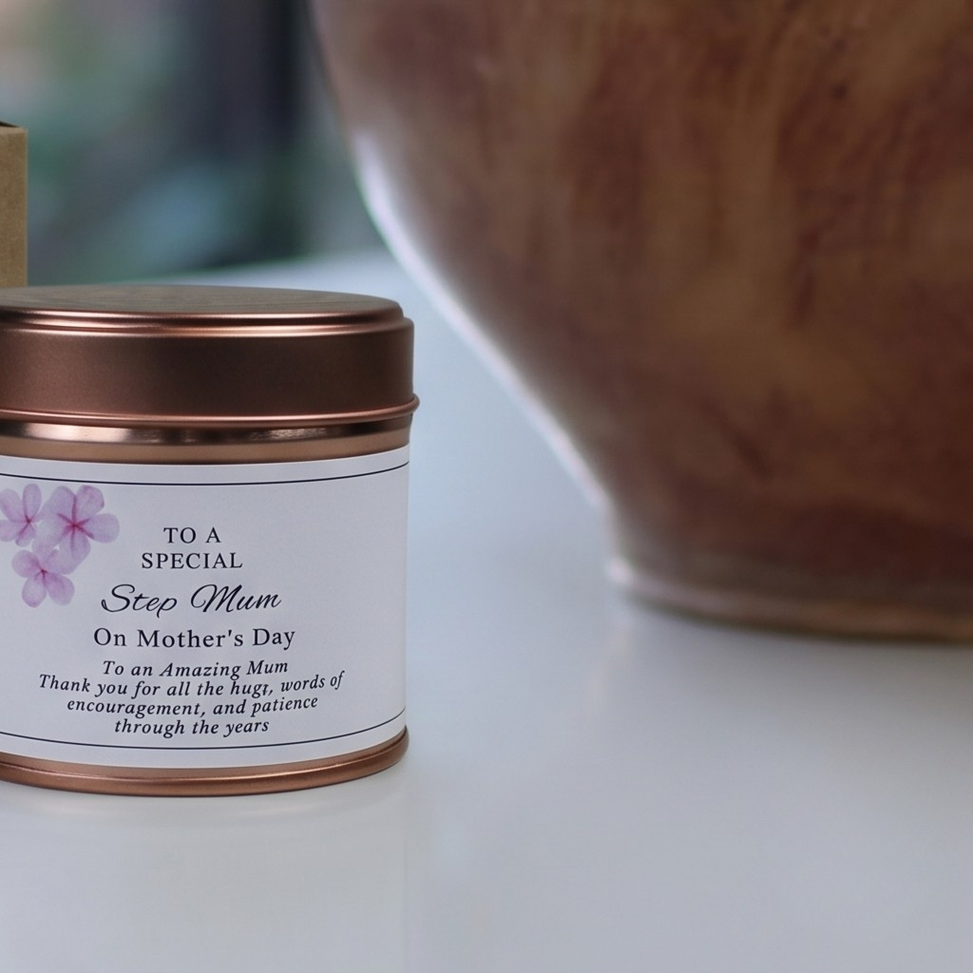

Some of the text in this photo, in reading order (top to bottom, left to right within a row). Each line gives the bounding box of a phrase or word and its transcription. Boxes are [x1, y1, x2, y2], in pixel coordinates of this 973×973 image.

[163, 526, 222, 545] TO A
[141, 552, 244, 570] SPECIAL
[100, 583, 283, 618] Step Mum
[93, 627, 296, 652] On Mother's Day
[103, 660, 289, 680] To an Amazing Mum
[39, 674, 91, 693] Thank
[94, 683, 129, 698] you
[130, 680, 161, 700] for
[166, 681, 191, 697] all
[196, 681, 225, 697] the
[280, 674, 326, 693] words
[329, 670, 346, 691] of
[67, 696, 319, 719] encouragement, and patience
[114, 718, 270, 739] through the years
